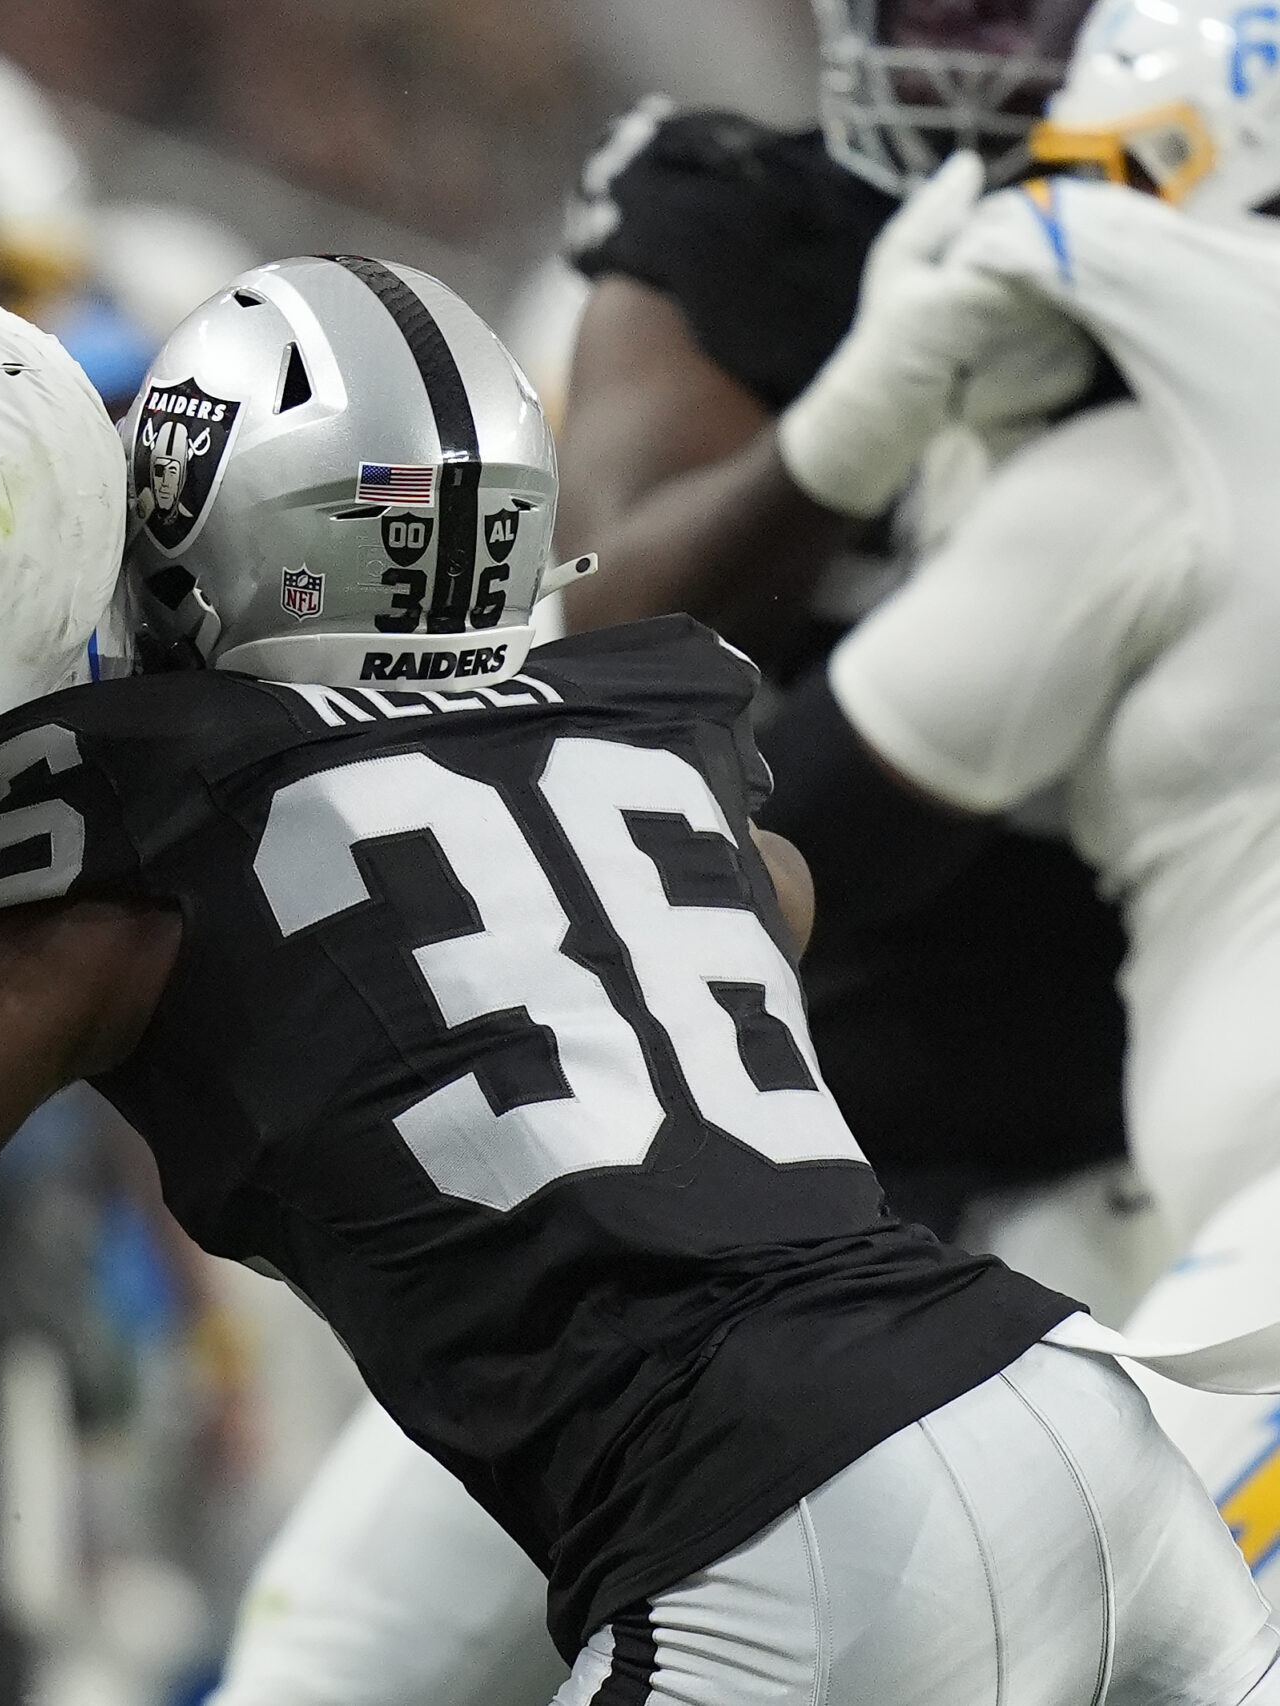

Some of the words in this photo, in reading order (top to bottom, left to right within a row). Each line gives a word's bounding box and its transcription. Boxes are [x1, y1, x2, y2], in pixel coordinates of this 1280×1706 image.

[148, 392, 227, 422] RAIDERS
[387, 521, 426, 548] 00
[489, 518, 515, 544] AL
[286, 588, 317, 612] NFL
[359, 643, 508, 681] RAIDERS
[252, 737, 873, 1213] 36
